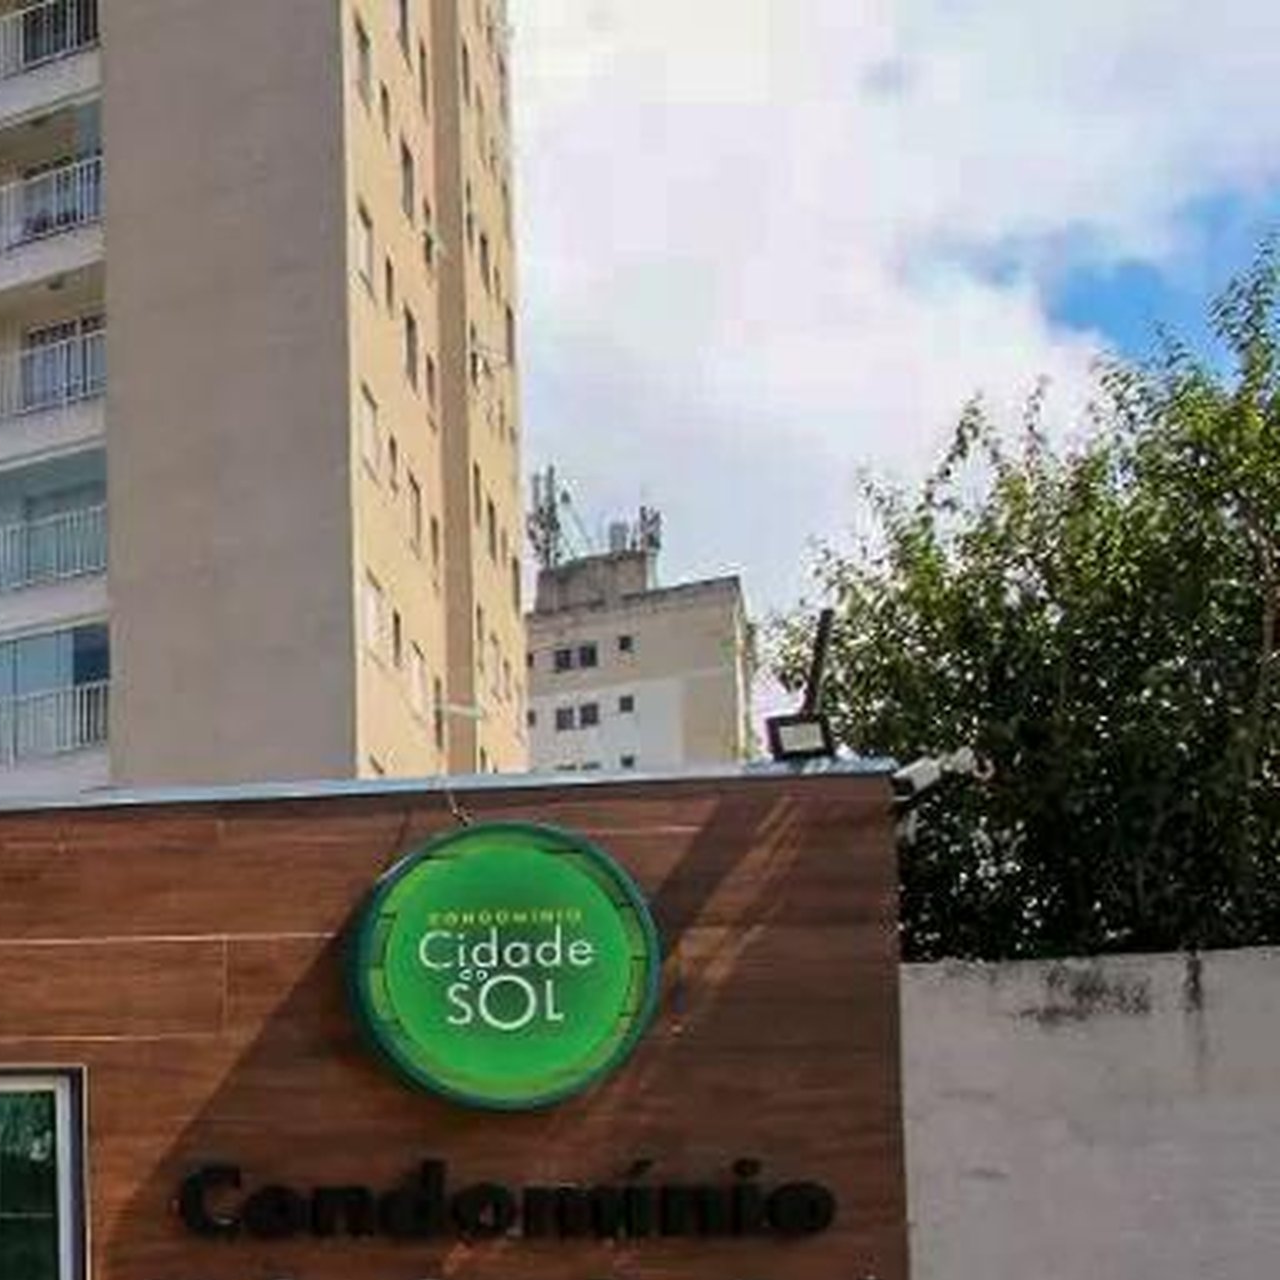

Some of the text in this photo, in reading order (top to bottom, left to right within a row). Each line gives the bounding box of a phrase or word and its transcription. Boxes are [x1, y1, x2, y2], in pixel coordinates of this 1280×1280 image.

[419, 924, 594, 969] Cidade
[447, 974, 564, 1030] SOL
[180, 1158, 834, 1240] Condomínio
